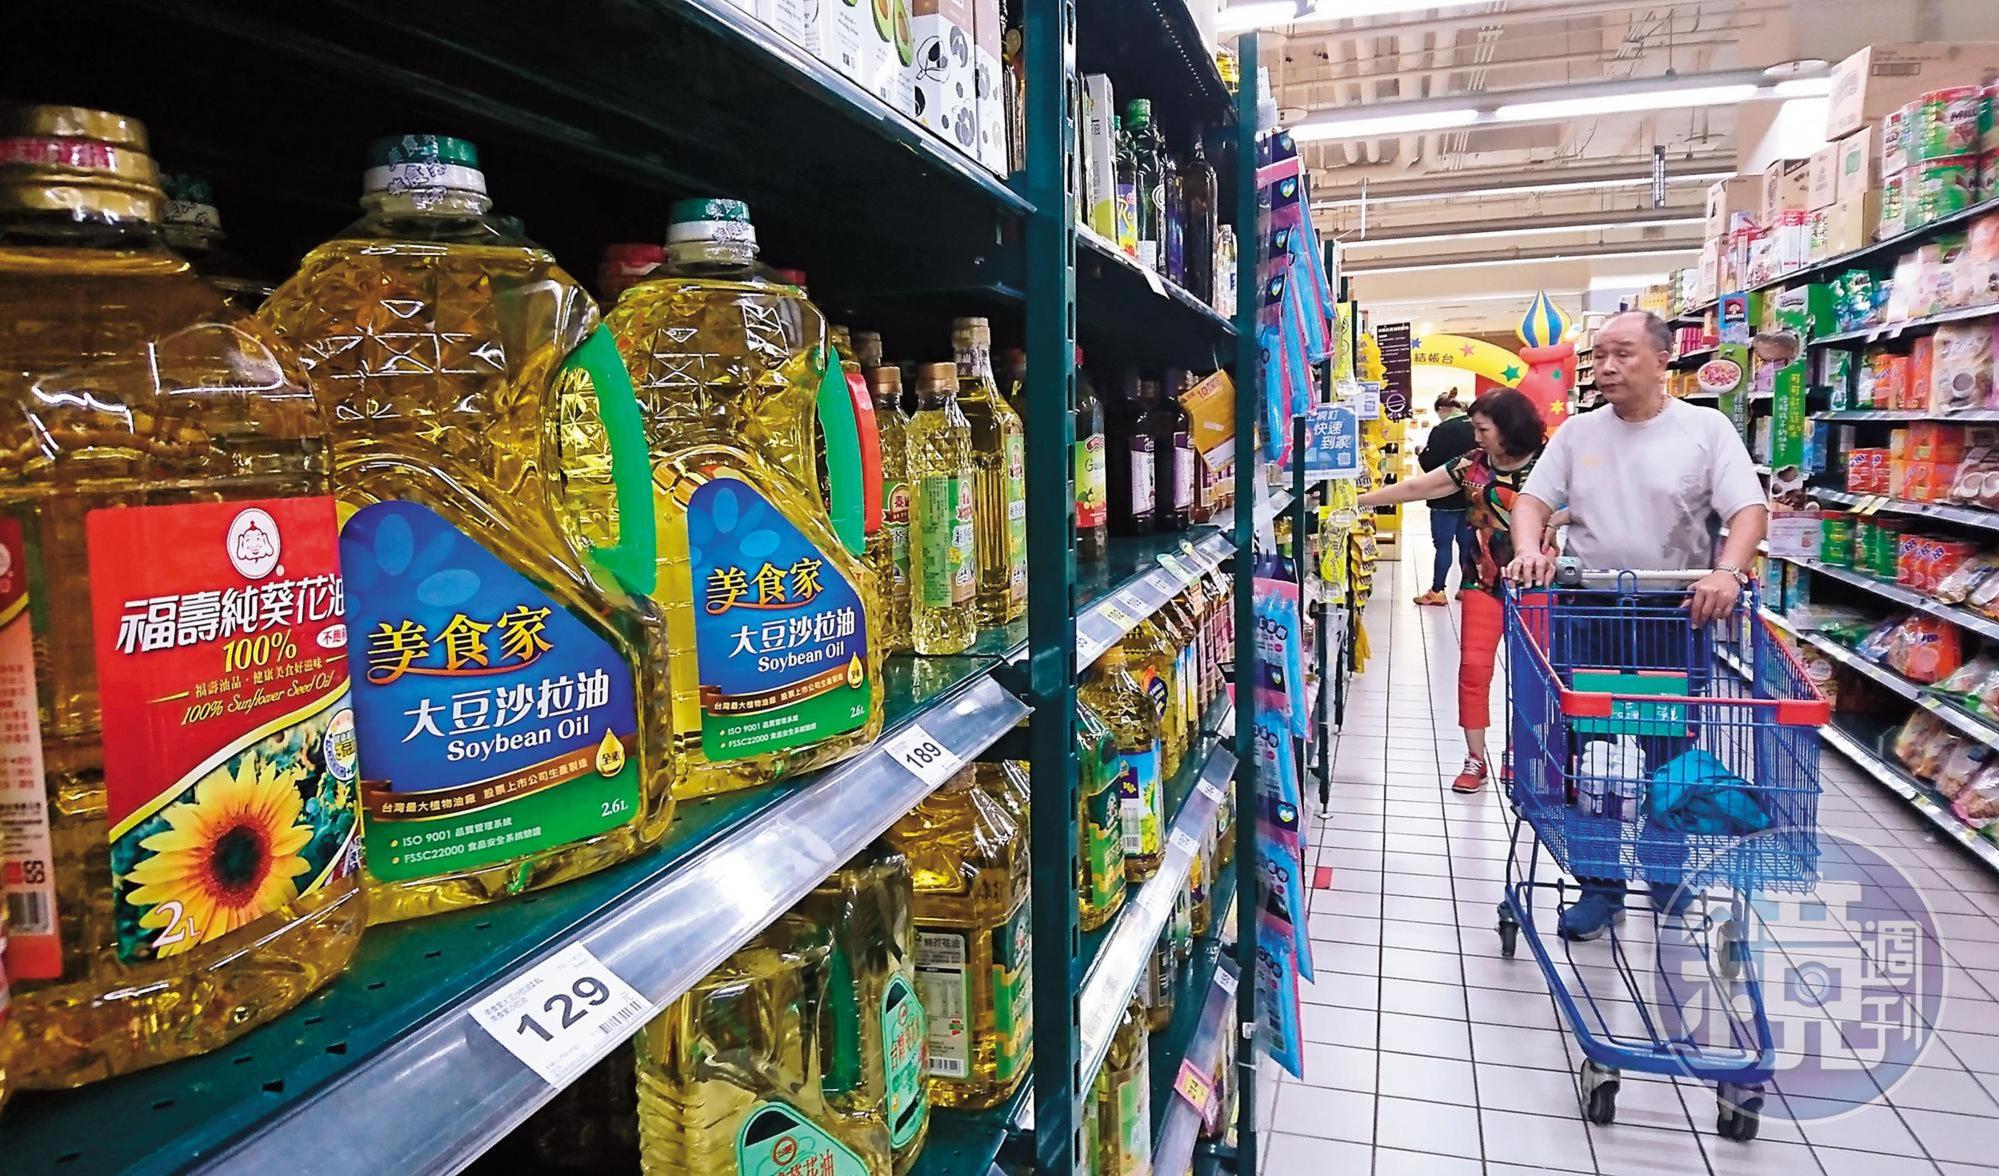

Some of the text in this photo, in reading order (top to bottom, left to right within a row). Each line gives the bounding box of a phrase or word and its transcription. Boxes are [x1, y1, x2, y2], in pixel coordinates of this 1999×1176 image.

[1414, 353, 1454, 364] 結帳台
[1313, 420, 1343, 436] 快速
[1319, 435, 1352, 450] 到家
[705, 557, 824, 615] 美食家
[116, 573, 346, 654] 福壽純葵花油
[728, 606, 855, 659] 大豆沙拉油
[223, 629, 297, 672] 100%
[367, 605, 554, 684] 美食家
[757, 640, 845, 673] Soybean Oil
[181, 670, 335, 725] 100% Sunflower Seed Oil
[401, 668, 609, 743] 大豆沙拉油
[447, 716, 590, 761] Soybean Oil
[728, 726, 741, 735] ISO
[743, 724, 760, 733] 9001
[728, 734, 769, 748] FSSC22000
[905, 742, 942, 769] 189
[382, 757, 589, 814] 台灣最大植物油廠 股票上市公司生產製造
[601, 798, 629, 817] 2.6L
[402, 817, 512, 847] ISO 9001 品質管理系統
[404, 827, 542, 863] FSSC22000 食品安全系統驗證
[152, 899, 200, 948] 2L
[516, 976, 610, 1042] 129
